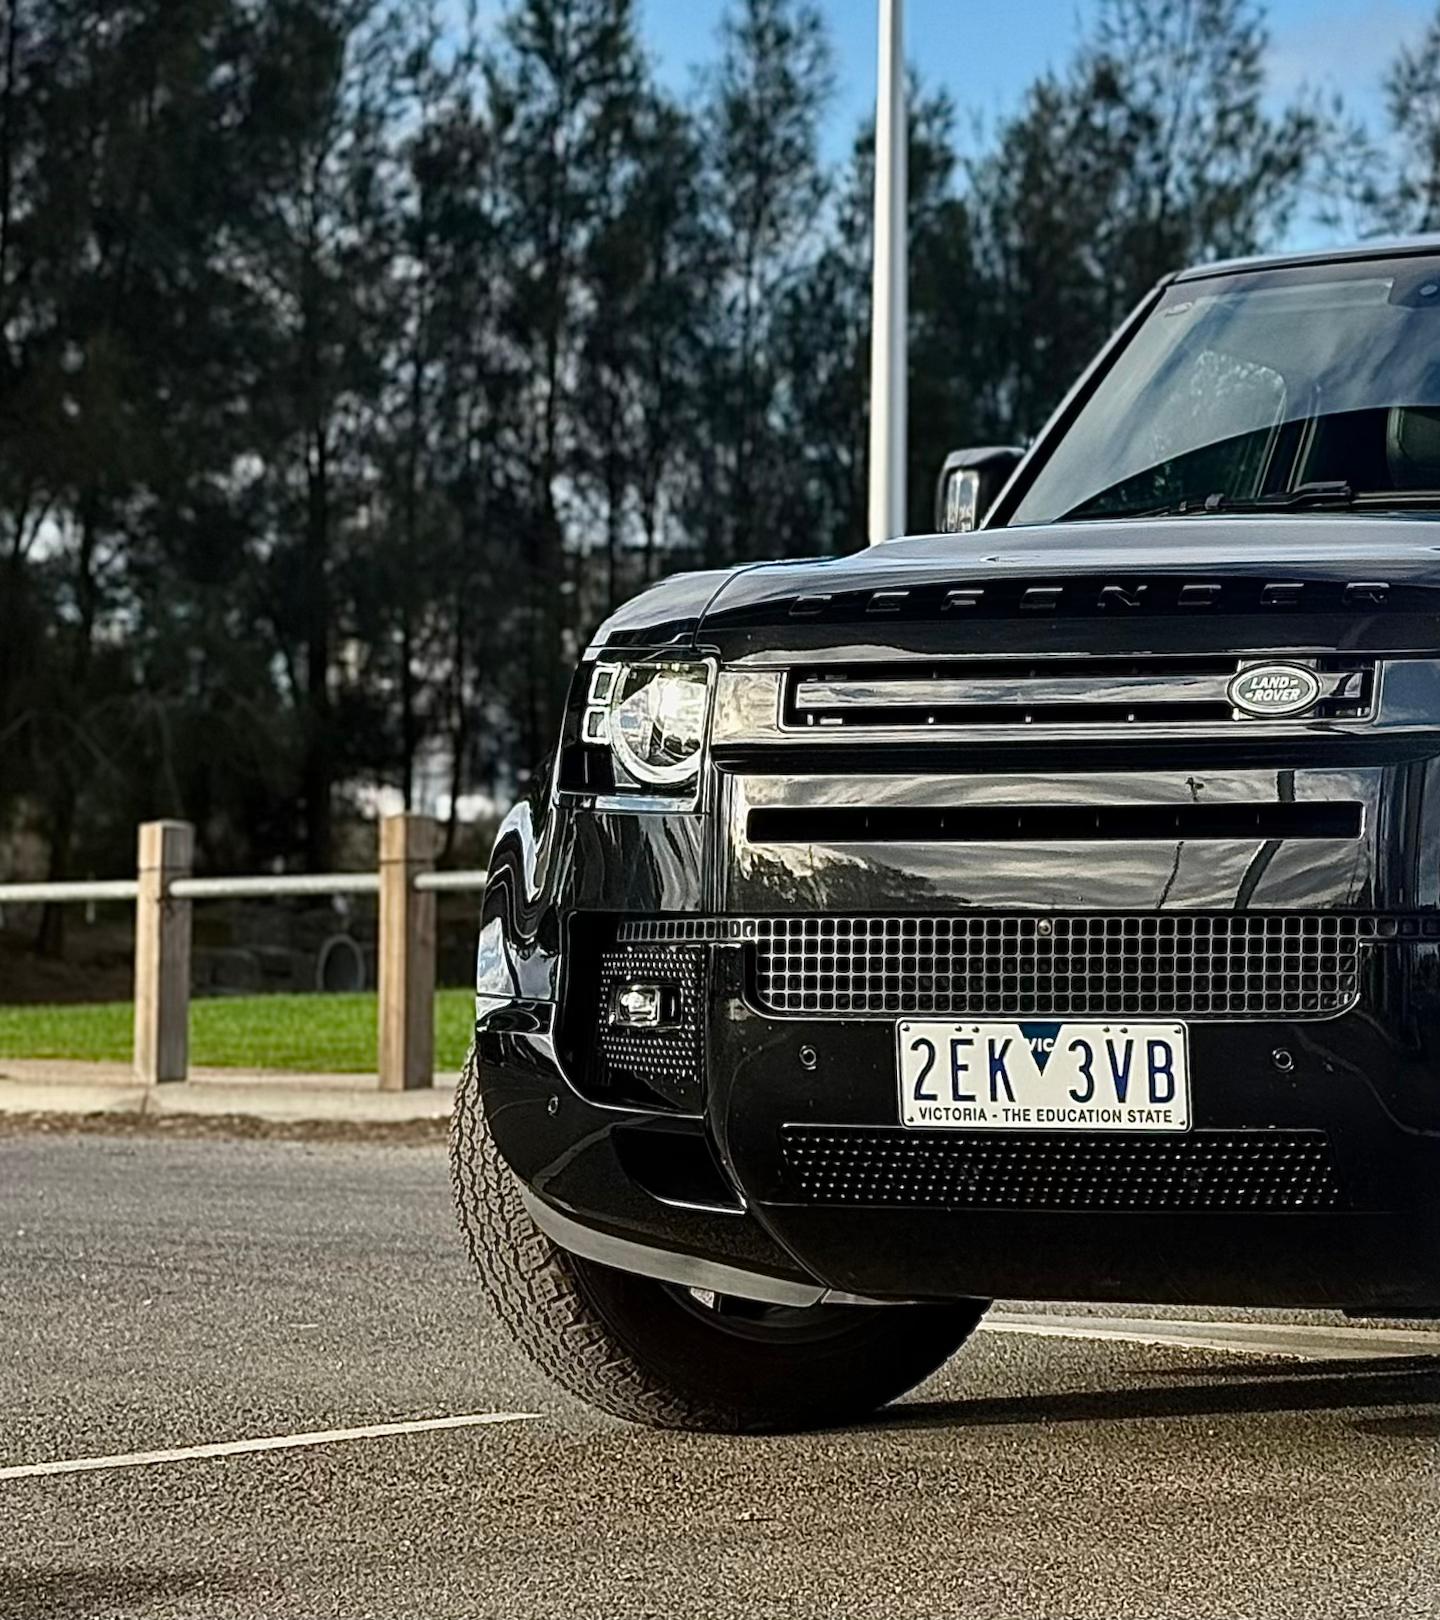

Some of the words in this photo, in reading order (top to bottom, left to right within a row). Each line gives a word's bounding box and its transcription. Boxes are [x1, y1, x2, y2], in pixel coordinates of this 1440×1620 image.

[1251, 676, 1290, 689] LAND
[1252, 688, 1301, 701] ROVER
[1024, 1037, 1055, 1052] VIC
[910, 1038, 1016, 1102] 2EK
[1068, 1039, 1175, 1104] 3VB
[919, 1107, 988, 1122] VICTORIA
[1004, 1108, 1031, 1123] THE
[1037, 1108, 1123, 1124] EDUCATION
[1127, 1109, 1173, 1124] STATE
